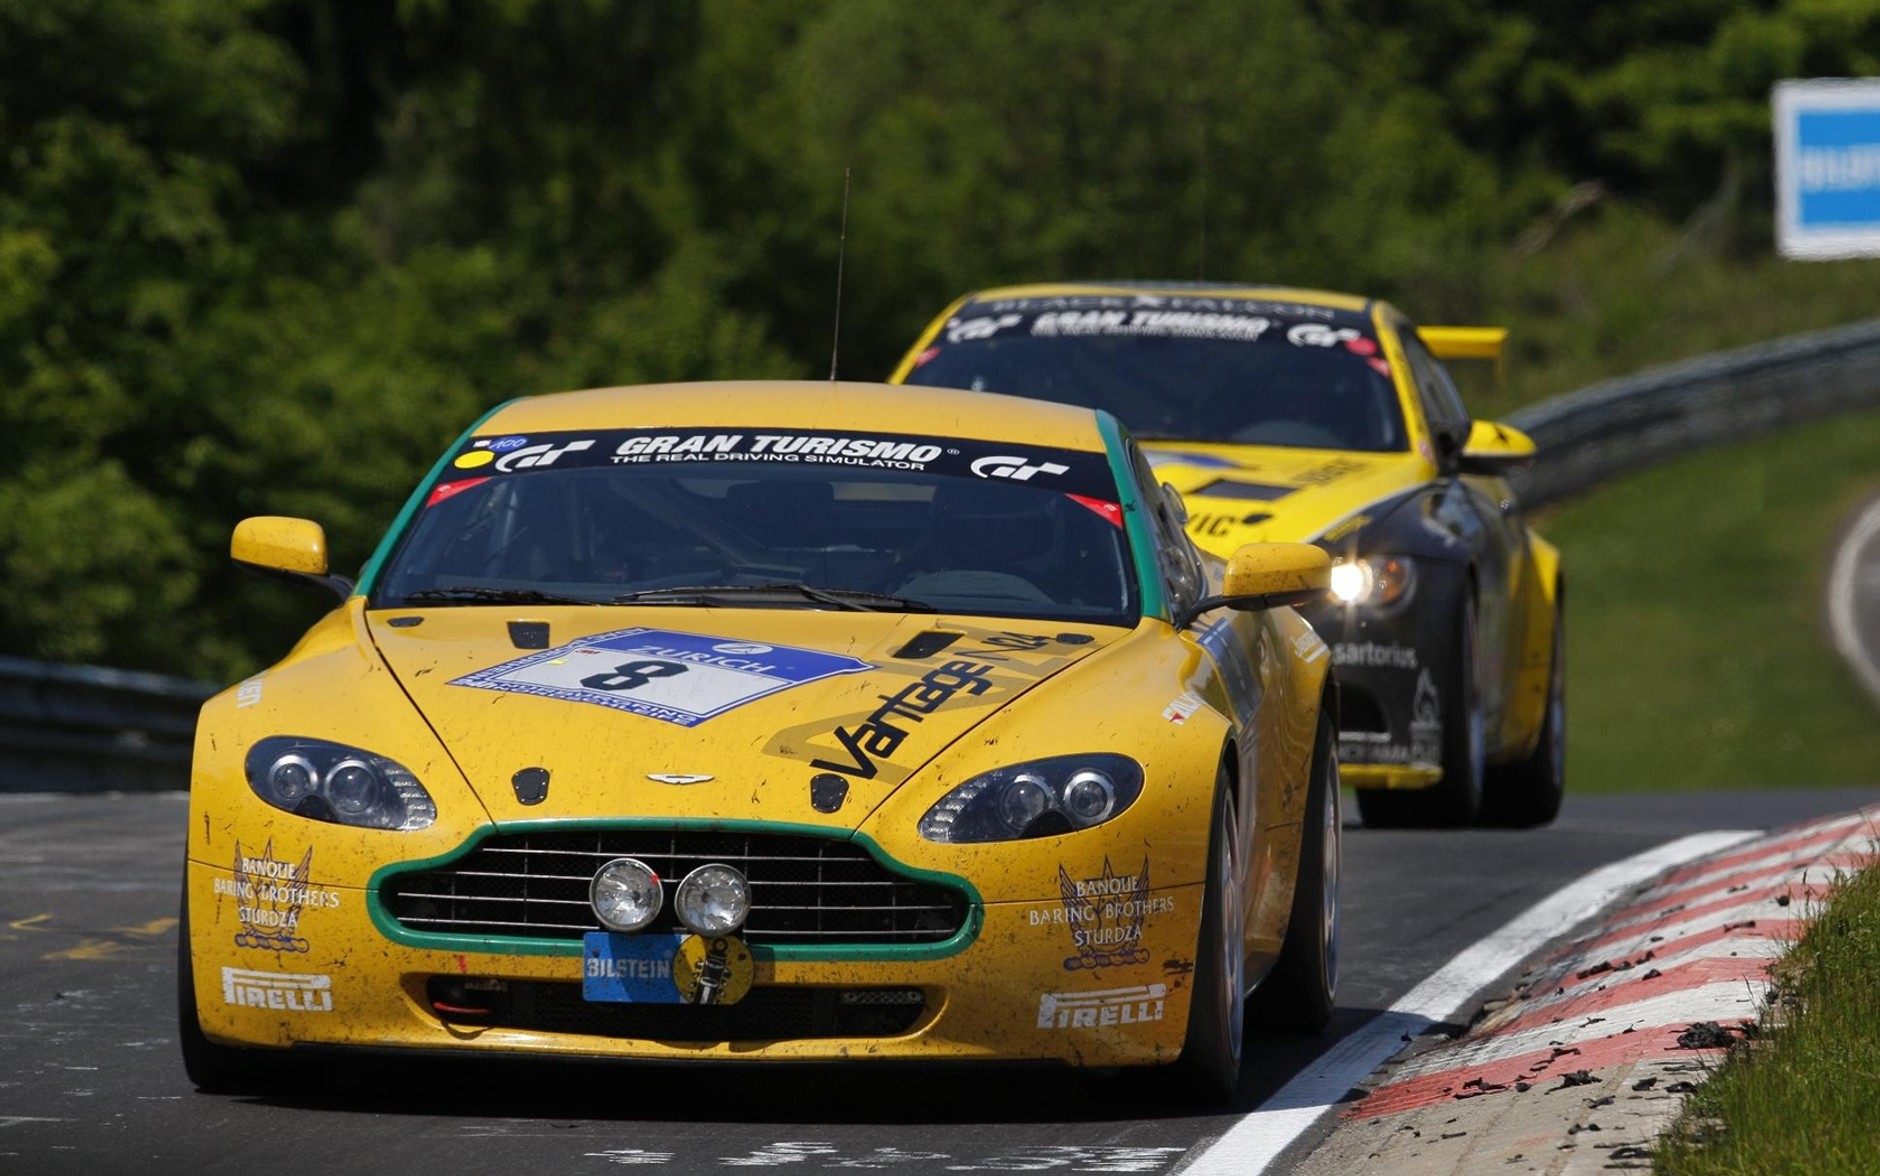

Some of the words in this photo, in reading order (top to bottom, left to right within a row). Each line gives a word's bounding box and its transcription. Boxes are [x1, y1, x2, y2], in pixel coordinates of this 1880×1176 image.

[610, 454, 652, 464] THE
[655, 452, 710, 462] REAL
[713, 452, 800, 462] DRIVING
[804, 453, 925, 471] SIMULATOR
[615, 434, 744, 456] GRAN
[750, 434, 943, 463] TURISMO
[628, 644, 777, 674] ZURICH
[1332, 640, 1419, 670] sartorius
[579, 659, 690, 691] 8
[808, 659, 996, 781] Vantage
[241, 857, 297, 882] BANQUE
[213, 877, 253, 900] BARING
[261, 885, 341, 909] BROTHERS
[1075, 875, 1140, 898] BANQUE
[238, 906, 299, 929] STURDZA
[1028, 905, 1096, 926] BARING
[1104, 895, 1175, 920] BROTHERS
[1073, 925, 1143, 947] STURDZA
[586, 957, 671, 979] BILSTEIN
[220, 966, 334, 1013] PIRELLI
[1035, 982, 1168, 1030] PIRELLI
